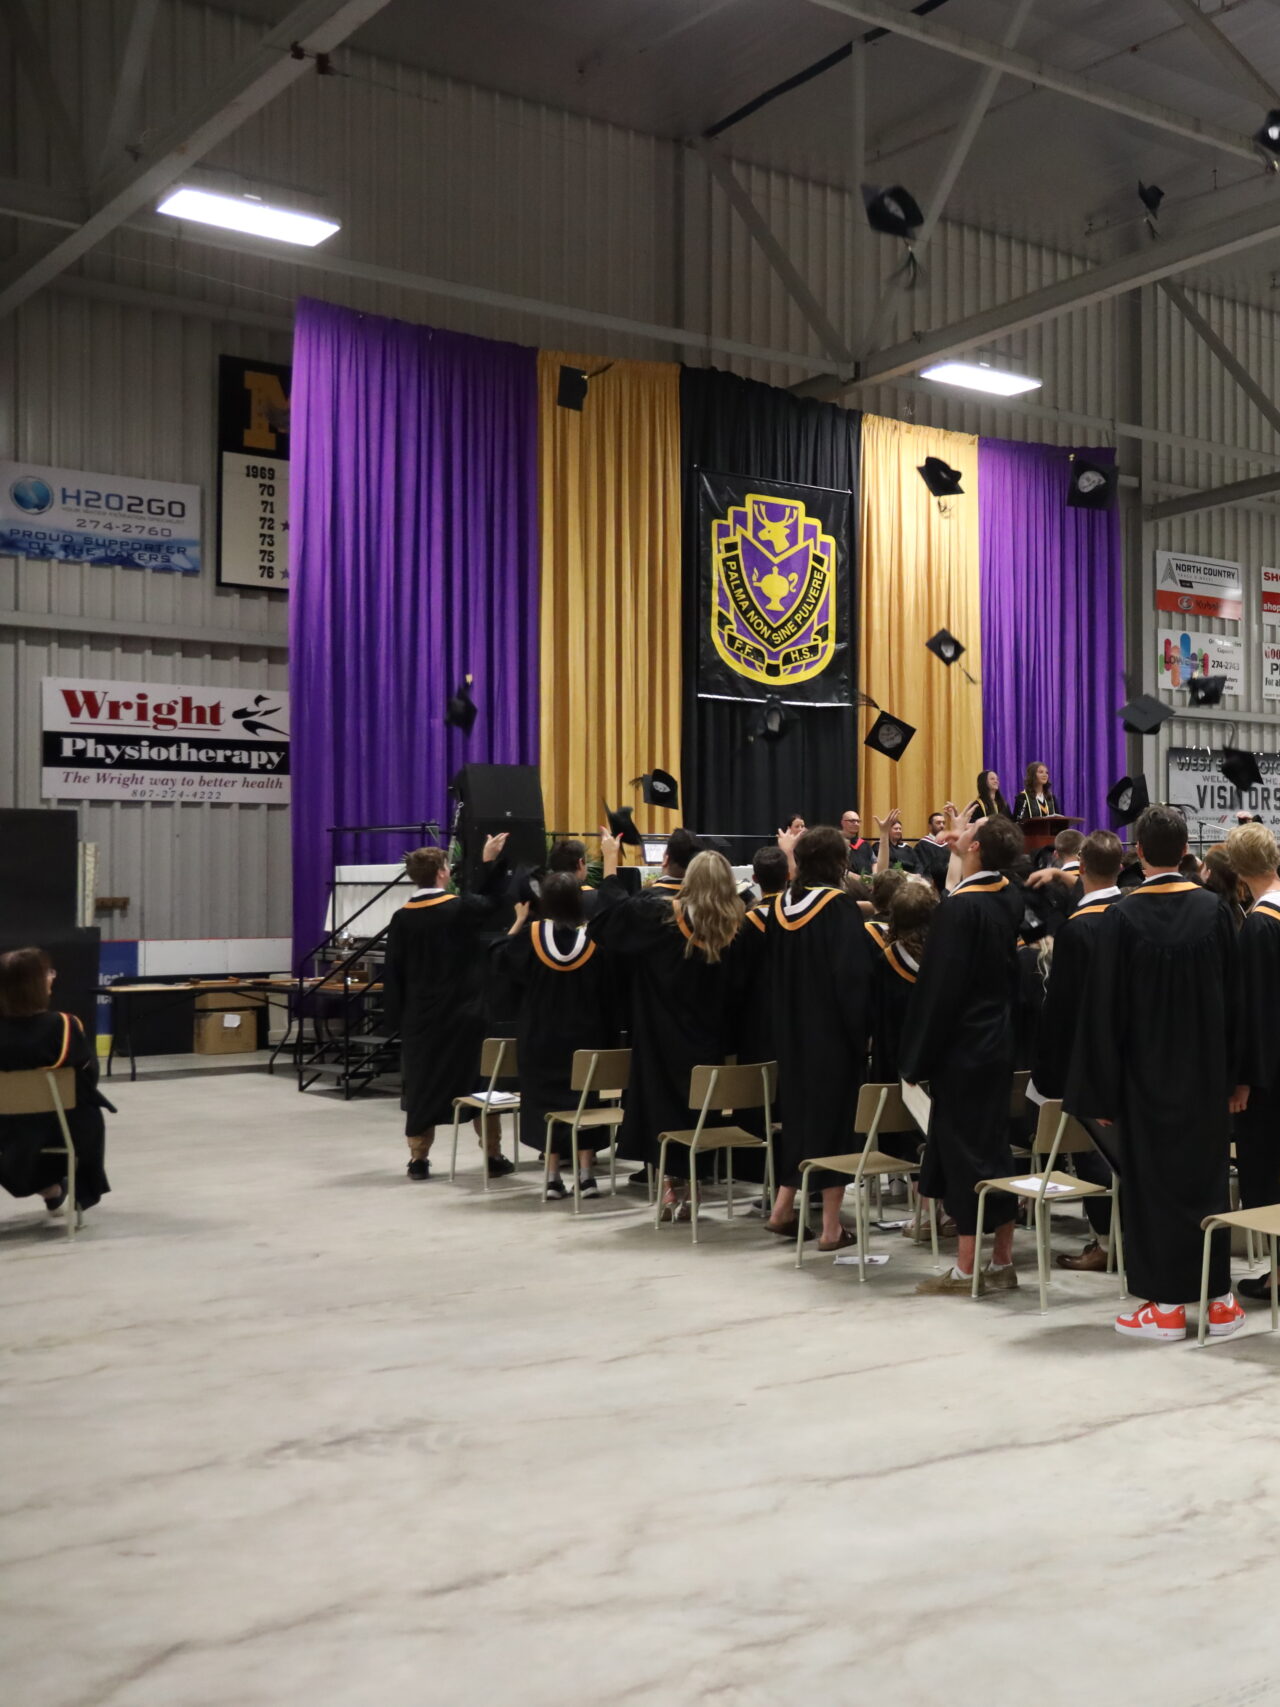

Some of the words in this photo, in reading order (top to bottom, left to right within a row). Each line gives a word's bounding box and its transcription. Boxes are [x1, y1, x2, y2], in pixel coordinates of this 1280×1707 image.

[246, 465, 275, 481] 1969
[259, 483, 275, 497] 70
[261, 500, 275, 514] 71
[76, 518, 172, 537] 274-2760
[259, 517, 274, 530] 72
[10, 528, 74, 543] PROUD
[83, 537, 187, 554] SUPPORTER
[259, 533, 274, 547] 73
[28, 541, 54, 555] OF
[61, 543, 97, 556] THE
[104, 549, 171, 563] LAKERS
[259, 549, 274, 563] 75
[259, 565, 274, 579] 76
[1175, 563, 1202, 574] NORTH
[1203, 567, 1236, 579] COUNTRY
[726, 561, 749, 611] PALMA
[746, 610, 771, 639] NON
[771, 621, 798, 644] SINE
[794, 570, 824, 625] PULVERE
[733, 639, 754, 658] F.F.
[790, 647, 814, 662] H.S.
[1265, 677, 1274, 686] For
[60, 689, 225, 731] Wright
[60, 737, 285, 769] Physiotherapy
[1177, 756, 1213, 772] WEST
[62, 771, 90, 784] The
[96, 772, 145, 788] Wright
[150, 778, 177, 789] way
[181, 776, 195, 788] to
[199, 776, 237, 789] better
[241, 777, 283, 789] health
[131, 789, 222, 800] 807-274-4222
